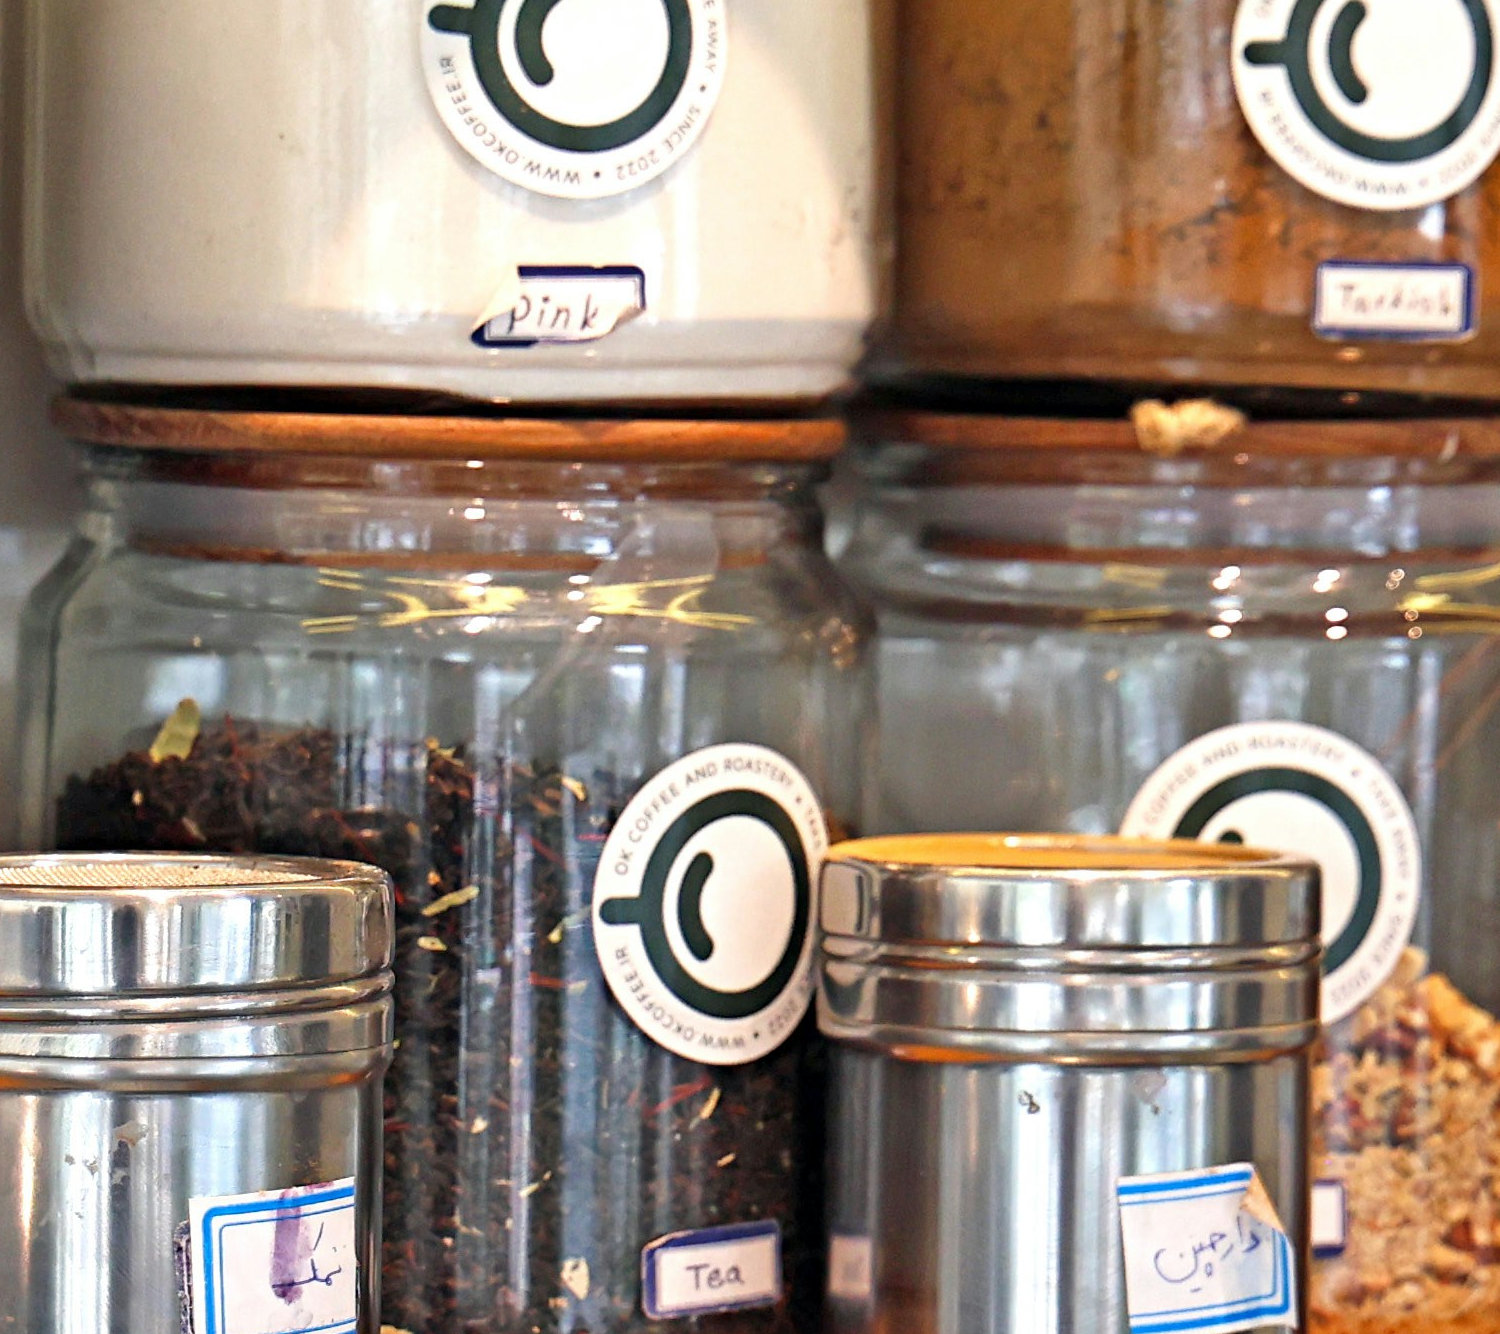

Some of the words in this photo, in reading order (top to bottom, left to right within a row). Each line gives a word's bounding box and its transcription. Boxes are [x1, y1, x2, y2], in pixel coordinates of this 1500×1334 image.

[704, 19, 717, 73] AWAY
[662, 106, 701, 153] SINCE
[615, 148, 660, 180] 2022
[629, 785, 681, 843] COFFEE
[685, 761, 718, 787] AND
[723, 758, 793, 788] ROASTERY
[686, 1263, 745, 1291] Tea
[1154, 1215, 1261, 1294] دارچین
